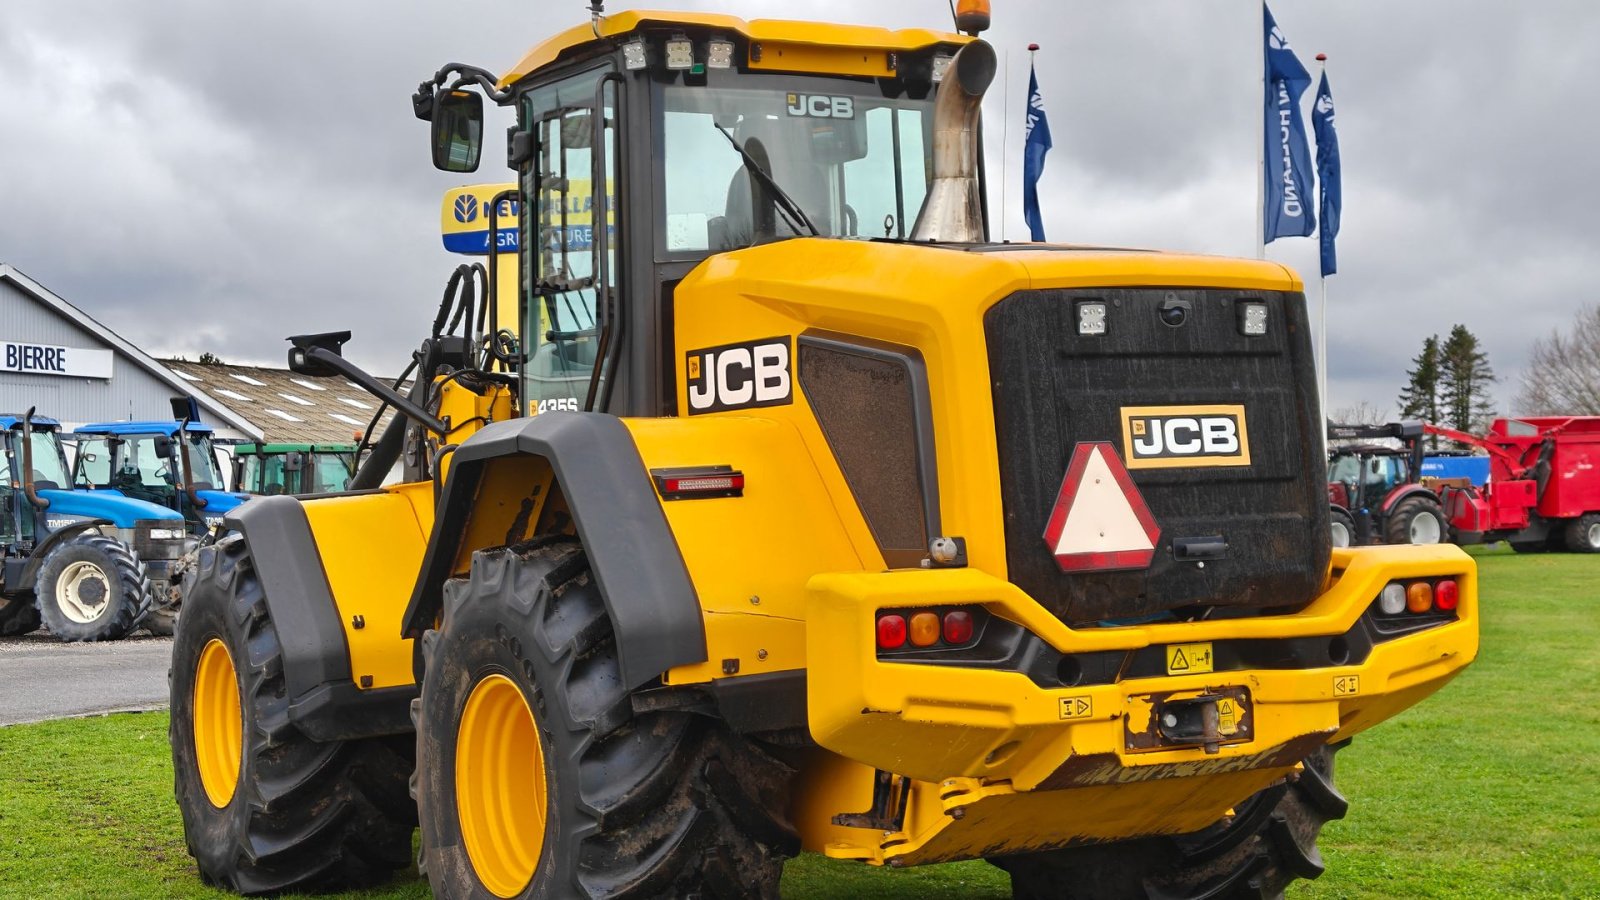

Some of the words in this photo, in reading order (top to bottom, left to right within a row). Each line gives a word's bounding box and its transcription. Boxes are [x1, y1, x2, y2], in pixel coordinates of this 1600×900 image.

[788, 94, 854, 118] JCB
[6, 344, 66, 373] BJERRE
[689, 342, 790, 409] JCB
[538, 397, 578, 415] 435S
[1134, 417, 1239, 455] JCB
